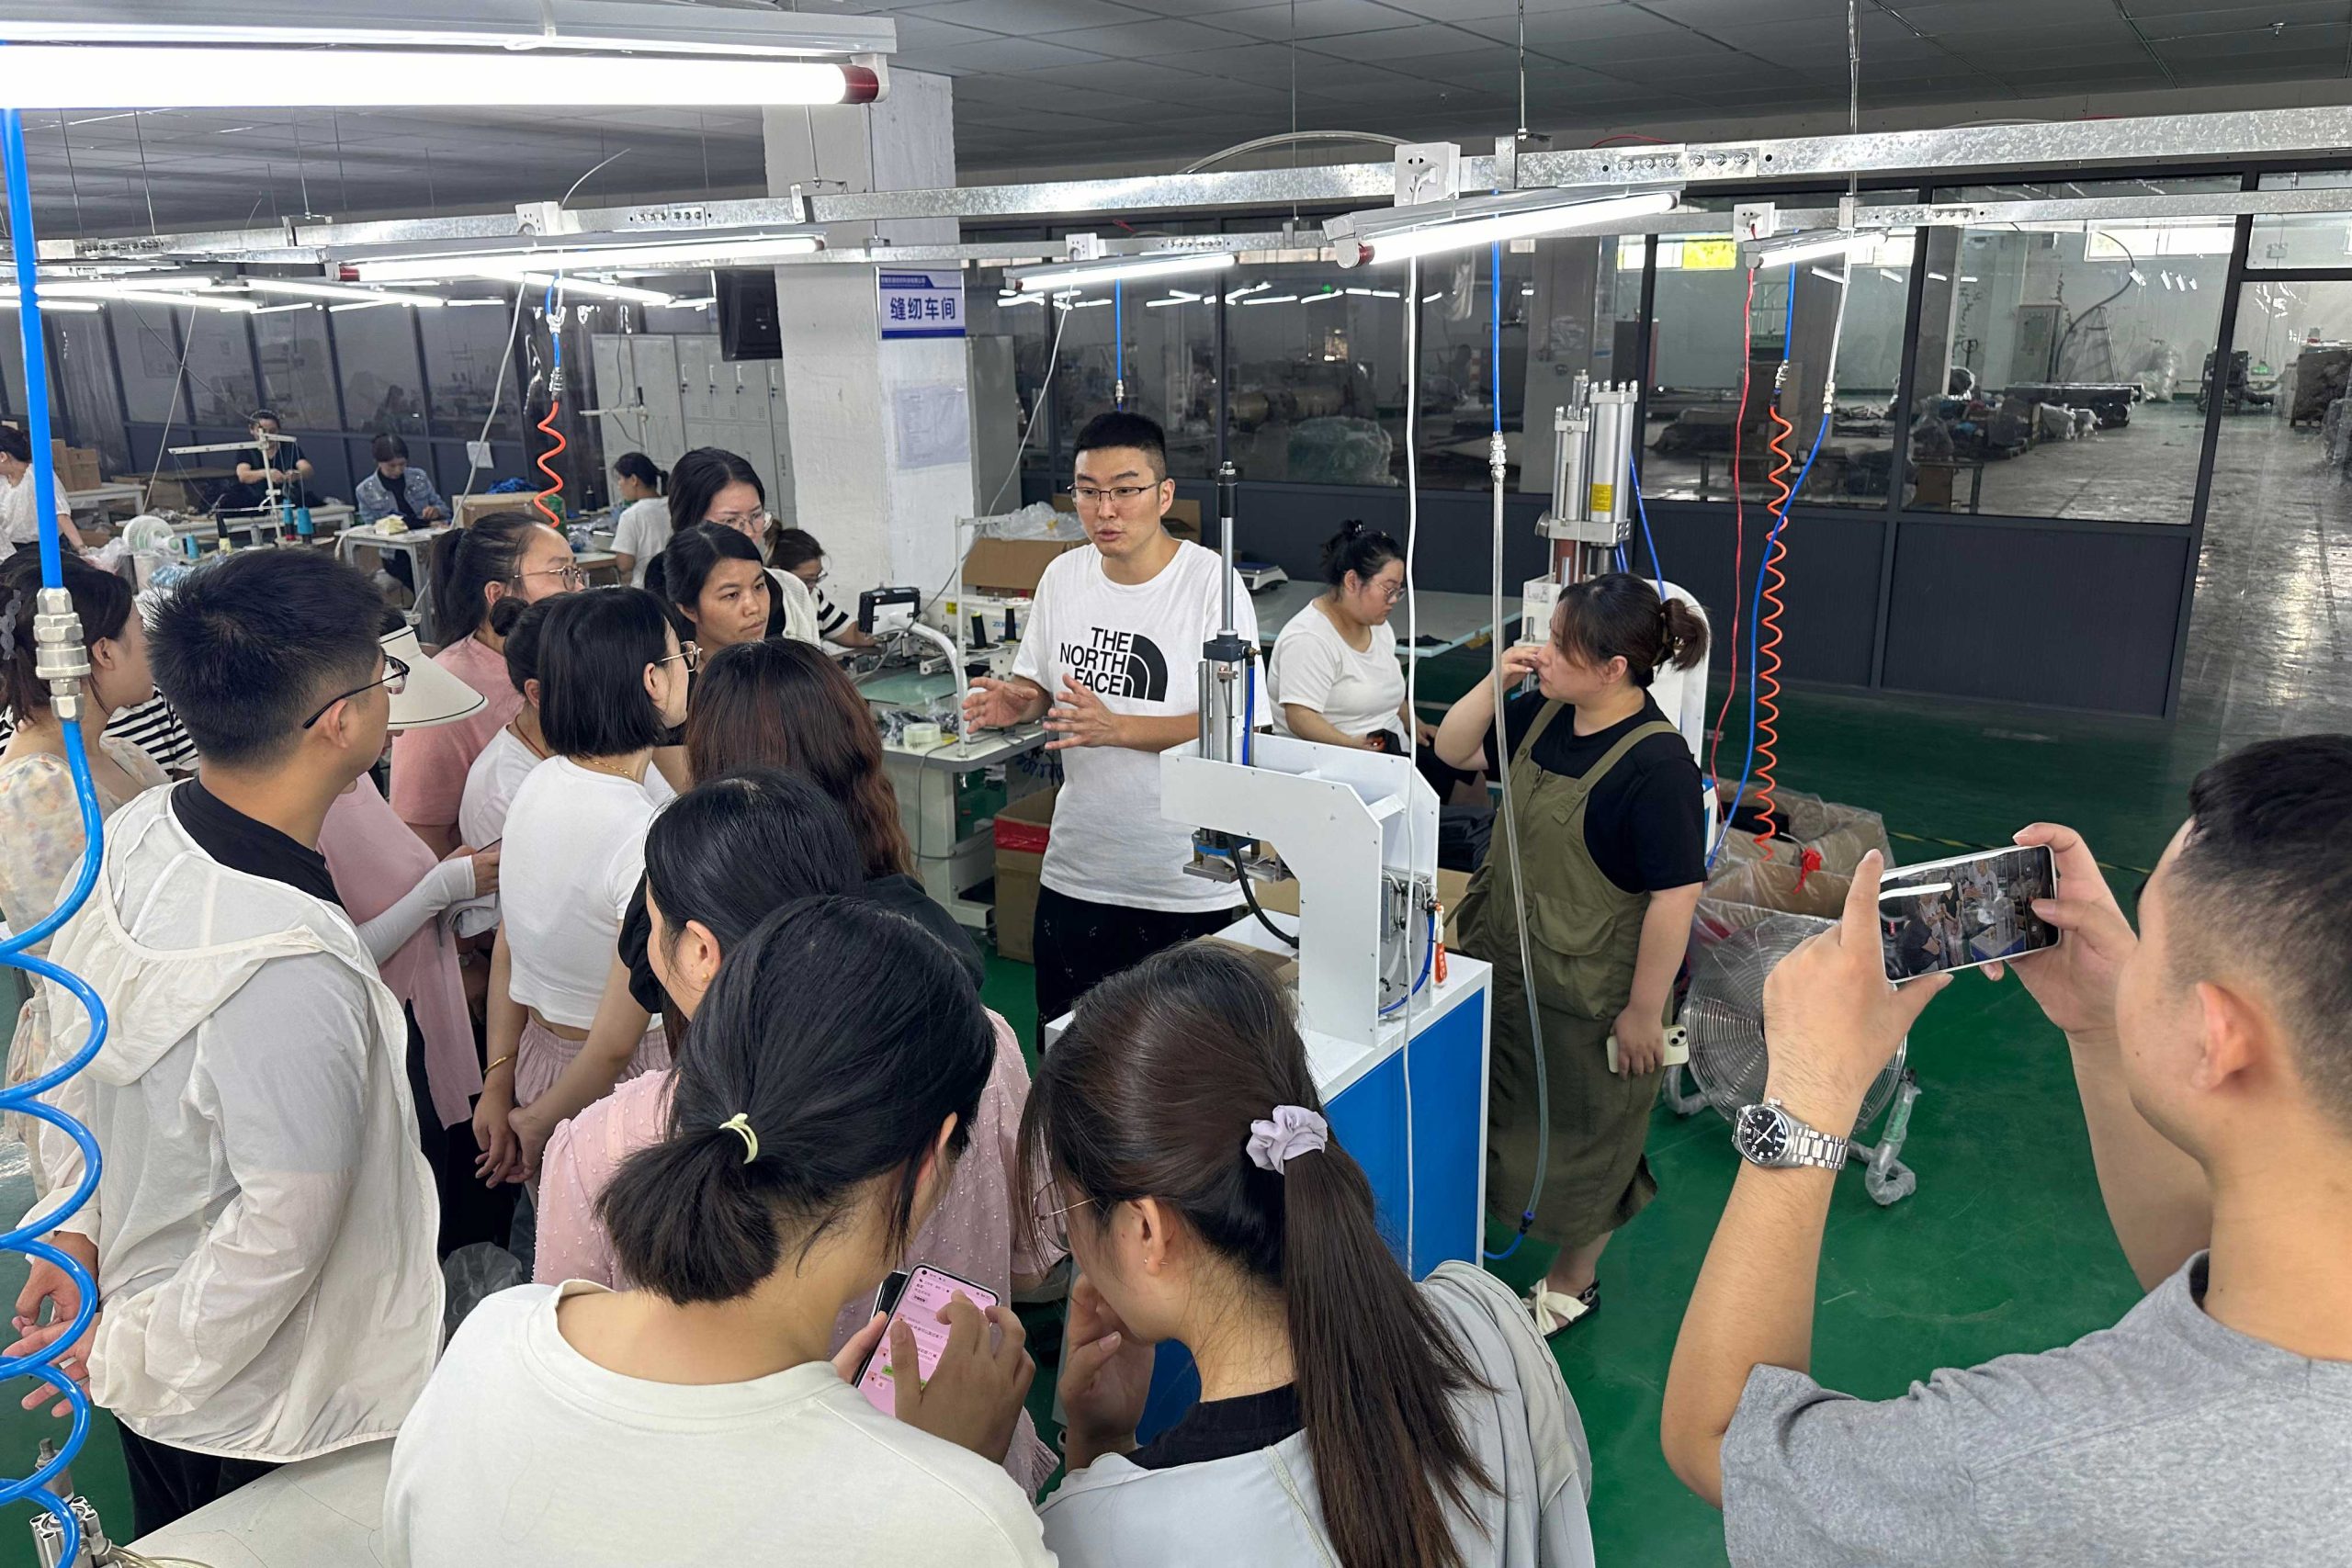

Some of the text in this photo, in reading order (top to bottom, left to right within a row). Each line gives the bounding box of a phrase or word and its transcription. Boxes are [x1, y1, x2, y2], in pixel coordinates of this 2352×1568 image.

[890, 297, 956, 321] 缝纫车间
[1091, 626, 1131, 652] THE
[1059, 642, 1126, 674] NORTH
[1074, 667, 1123, 696] FACE
